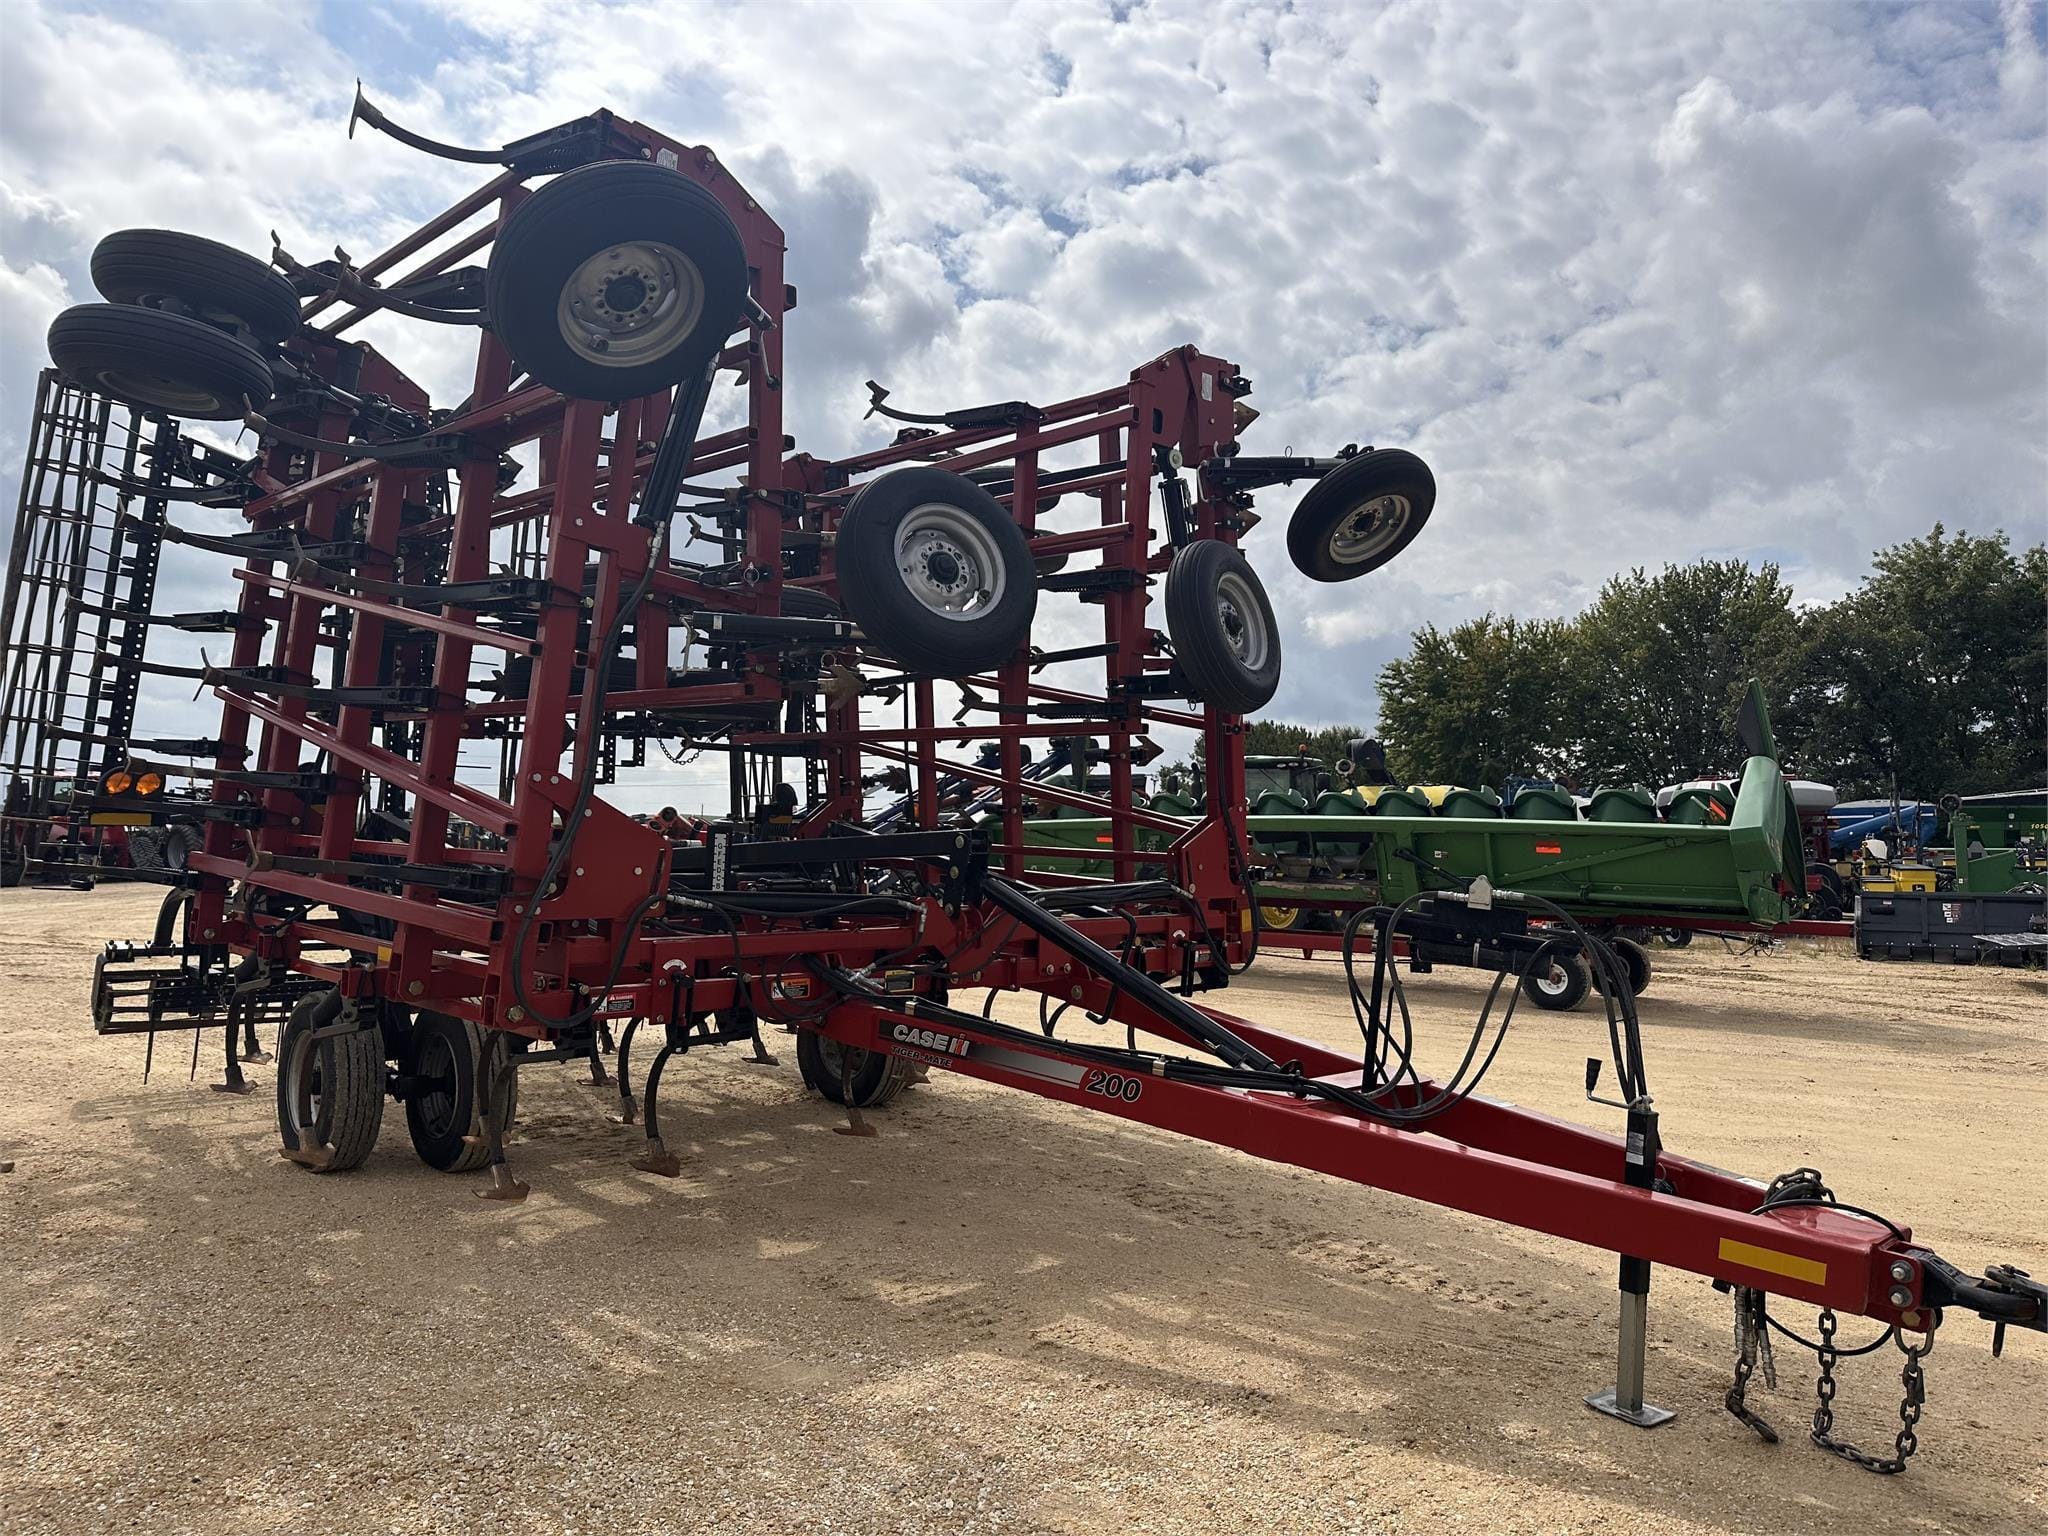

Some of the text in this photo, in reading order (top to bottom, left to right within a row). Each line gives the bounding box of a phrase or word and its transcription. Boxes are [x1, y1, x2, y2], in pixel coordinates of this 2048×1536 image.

[893, 1024, 950, 1053] CASE
[891, 1046, 953, 1068] TIGER-MATE
[1085, 1069, 1143, 1103] 200
